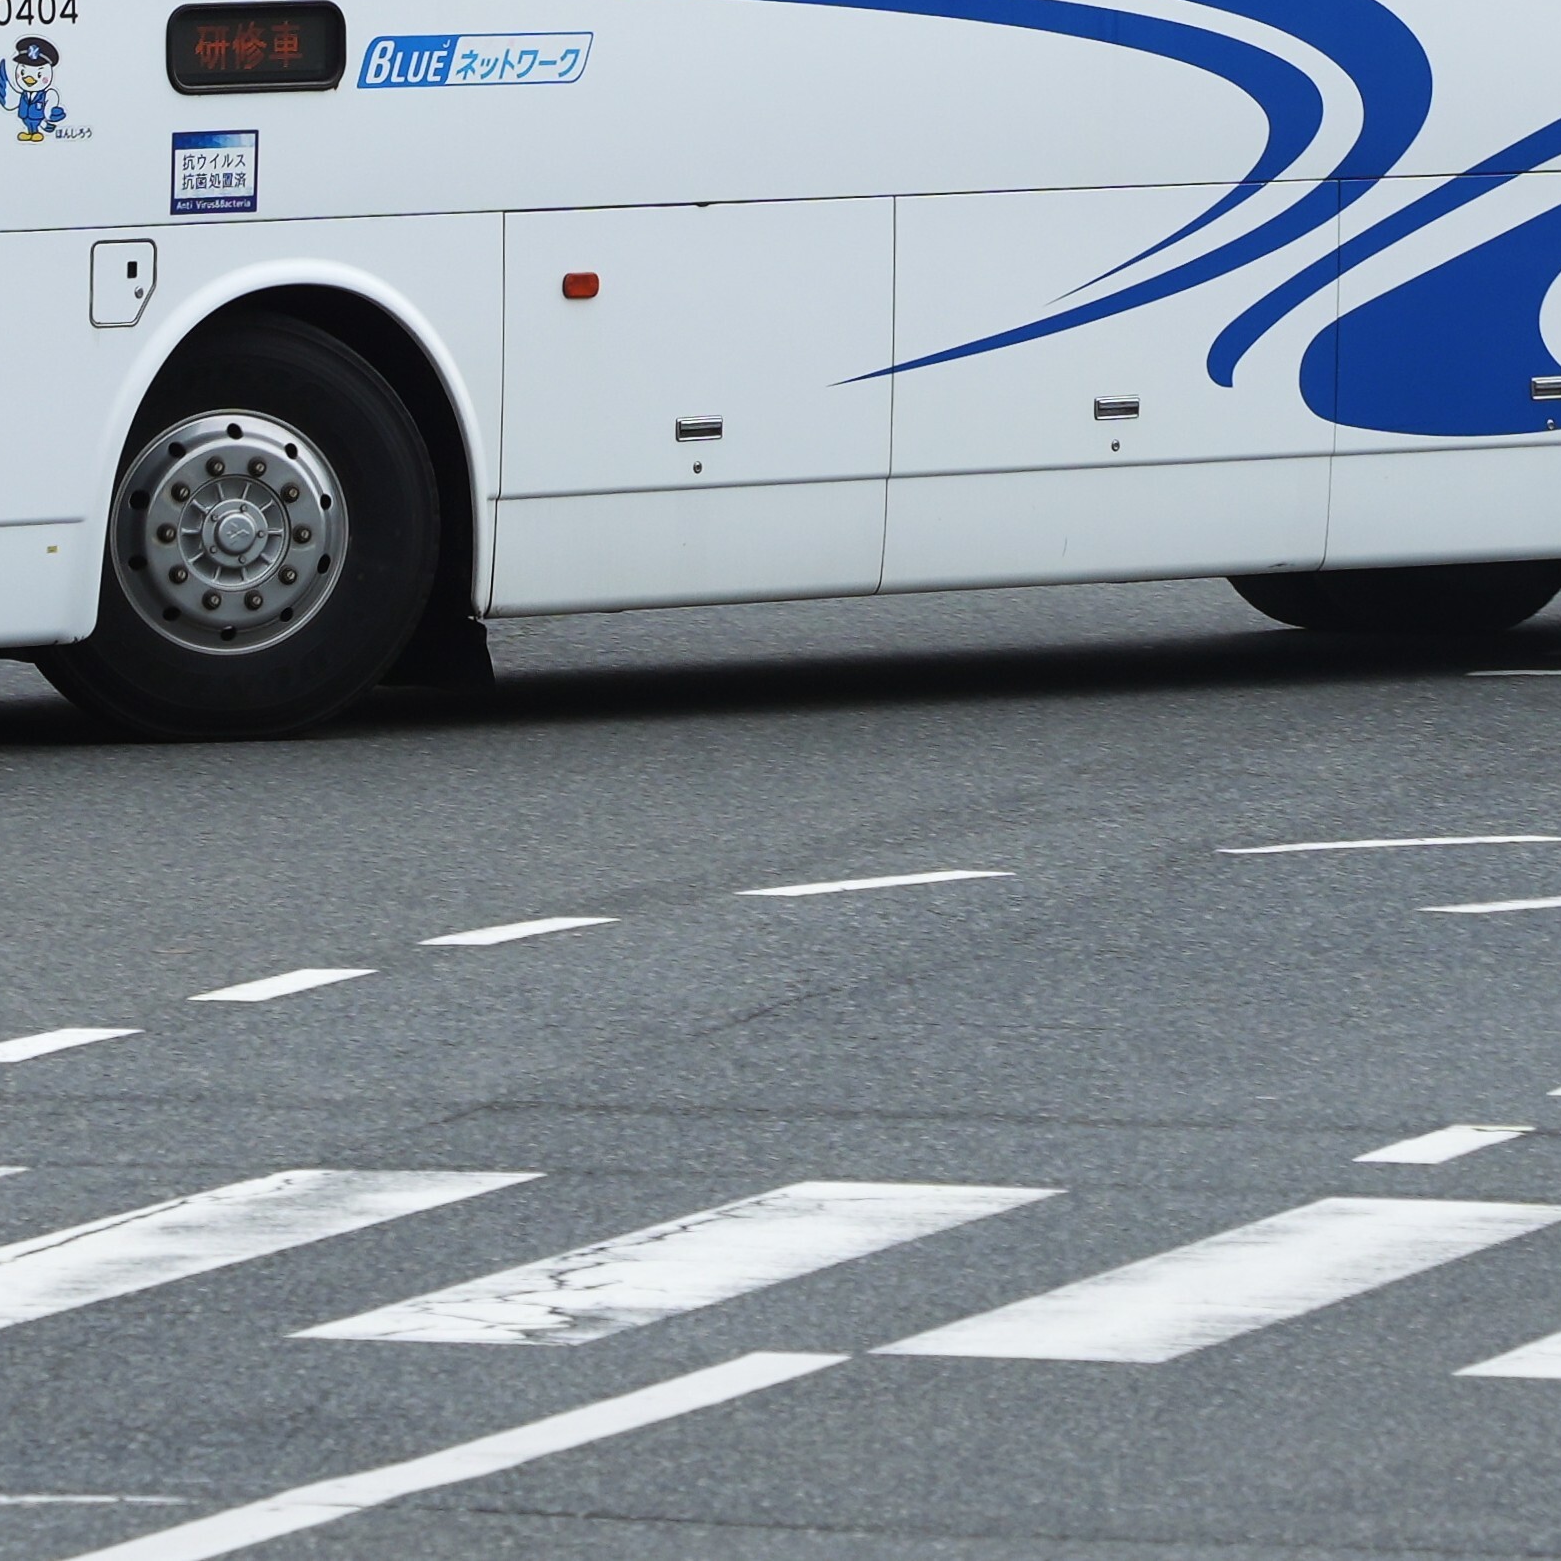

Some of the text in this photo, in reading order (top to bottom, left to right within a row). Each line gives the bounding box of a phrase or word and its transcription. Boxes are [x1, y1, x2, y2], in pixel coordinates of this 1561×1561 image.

[195, 21, 302, 70] 研修車
[365, 39, 581, 85] BLUE ネットワーク
[181, 153, 246, 171] 抗ウイルス
[181, 171, 247, 190] 抗菌処置済
